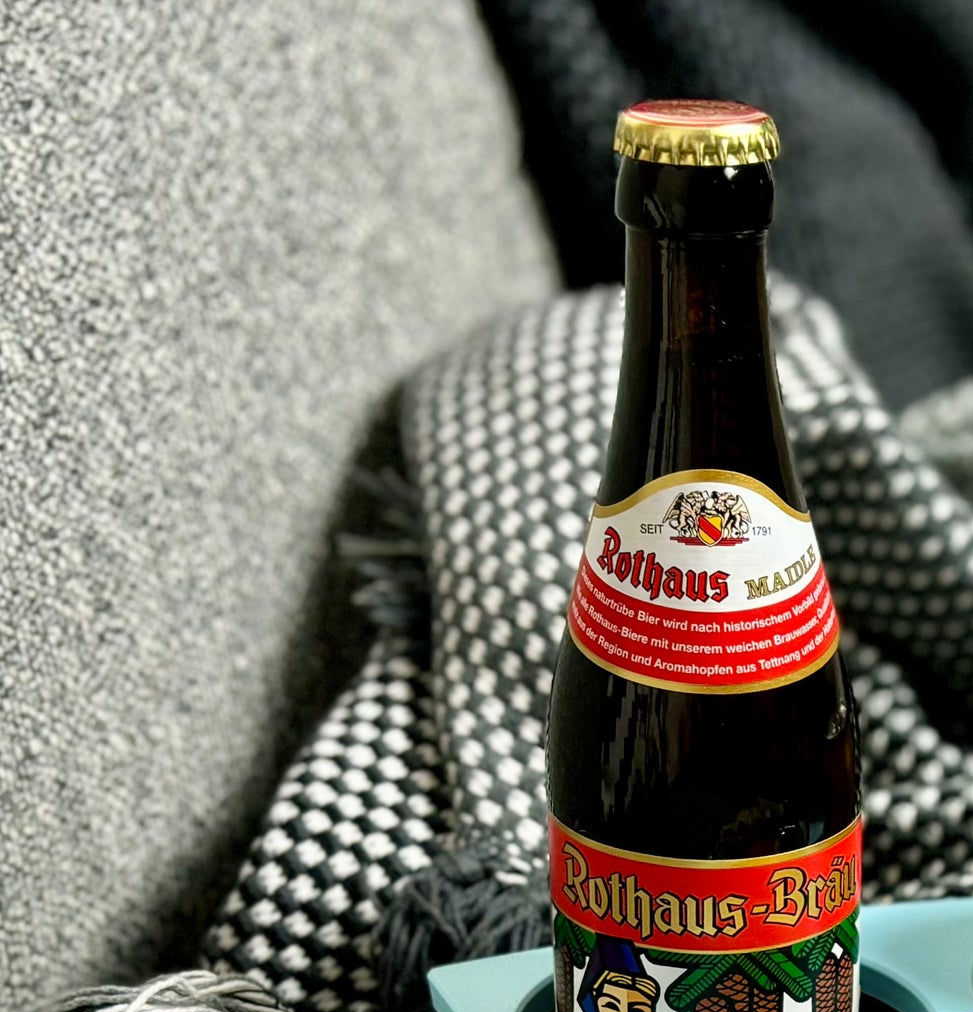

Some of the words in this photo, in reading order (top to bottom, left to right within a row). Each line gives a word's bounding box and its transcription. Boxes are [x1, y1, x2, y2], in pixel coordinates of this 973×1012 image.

[640, 523, 664, 535] SEIT
[752, 526, 772, 536] 1791
[597, 526, 730, 603] Rothaus
[744, 544, 817, 600] MAIDLE
[588, 605, 649, 645] Rothaus-Biere
[650, 637, 669, 650] mit
[671, 642, 723, 655] unserem
[726, 638, 772, 653] weichen
[773, 615, 820, 646] Brauwasser,
[593, 586, 634, 618] naturtrübe
[637, 610, 660, 626] Bier
[662, 618, 688, 631] wird
[690, 622, 721, 633] nach
[723, 610, 792, 633] historischem
[791, 593, 815, 617] Vorbild
[585, 627, 599, 641] der
[597, 635, 629, 659] Region
[631, 653, 652, 667] und
[654, 658, 734, 678] Aromahopfen
[736, 663, 757, 674] aus
[758, 649, 801, 671] Tettnang
[801, 641, 816, 656] und
[561, 842, 857, 941] Rothaus-Bräu
